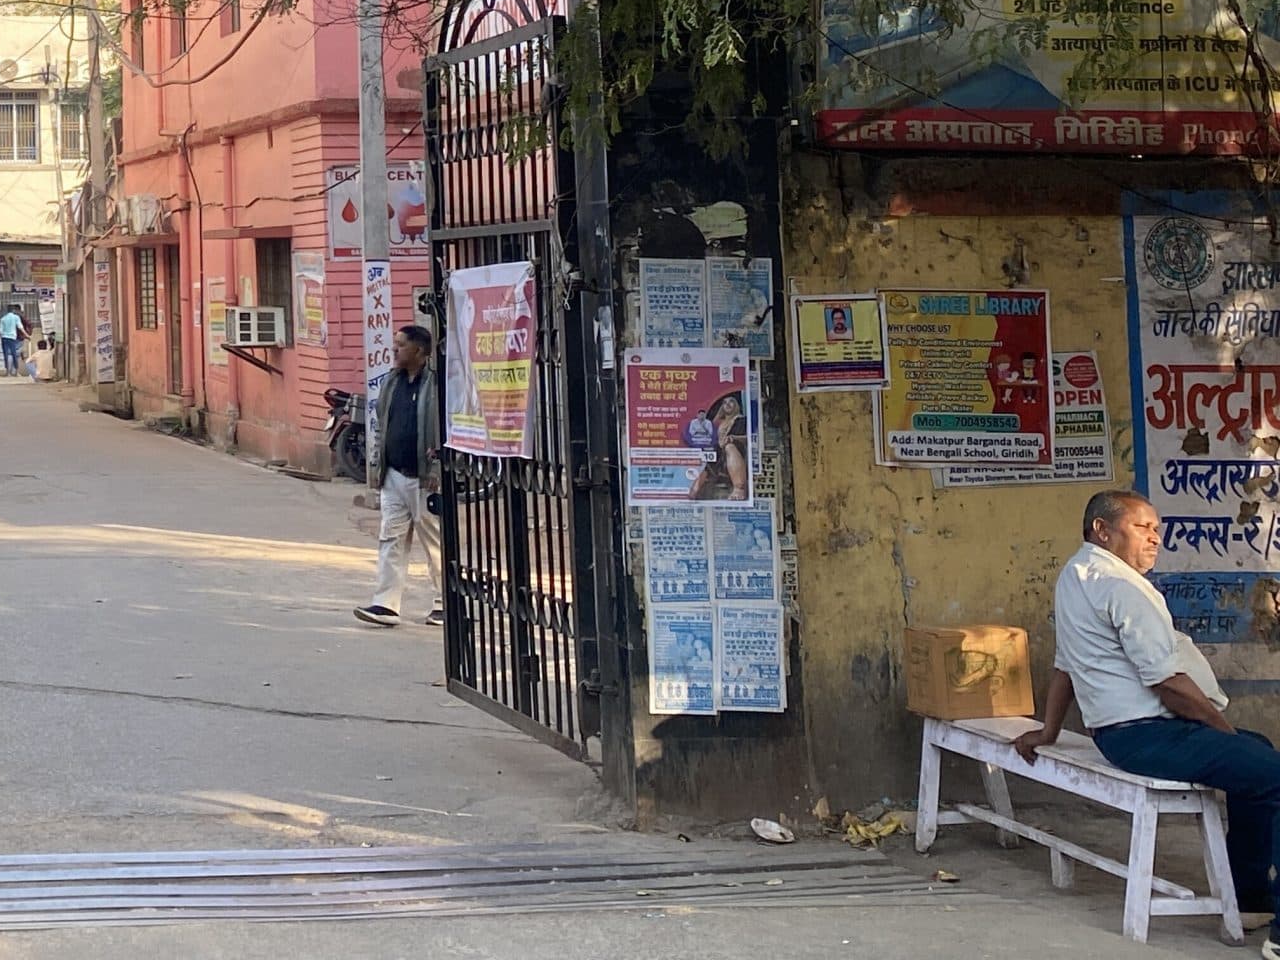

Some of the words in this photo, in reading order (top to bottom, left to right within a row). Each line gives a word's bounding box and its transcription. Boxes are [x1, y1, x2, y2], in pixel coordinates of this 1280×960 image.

[1194, 35, 1206, 52] से
[1186, 78, 1219, 91] ICU
[1054, 116, 1164, 146] गिरिडीह
[387, 170, 424, 181] CENT
[374, 296, 385, 309] X
[918, 295, 970, 316] SHREE
[975, 295, 1041, 316] LIBRARY
[368, 312, 390, 329] RAY
[1199, 302, 1224, 336] की
[887, 324, 903, 333] WHY
[906, 323, 938, 333] CHOOSE
[939, 324, 952, 334] US?
[374, 334, 383, 345] &
[368, 348, 391, 368] ECG
[899, 360, 926, 369] Private
[953, 360, 964, 369] for
[965, 360, 993, 370] Comfort
[639, 369, 661, 381] एक
[664, 370, 697, 381] मच्छर
[922, 371, 942, 380] CCTV
[937, 394, 960, 403] Power
[961, 394, 989, 403] Backup
[1055, 390, 1102, 406] OPEN
[921, 404, 938, 412] Pure
[952, 404, 974, 413] Water
[917, 417, 941, 427] Mob
[1055, 412, 1098, 422] PHARMACY
[891, 436, 915, 445] Add:
[917, 436, 963, 447] Makatpur
[967, 437, 1011, 448] Barganda
[1015, 437, 1042, 448] Road,
[704, 453, 714, 461] 10
[901, 448, 924, 457] Near
[927, 448, 961, 459] Bengali
[964, 448, 998, 459] School,
[1002, 449, 1034, 458] Giridih
[1055, 461, 1074, 471] sing
[1077, 461, 1104, 470] Home
